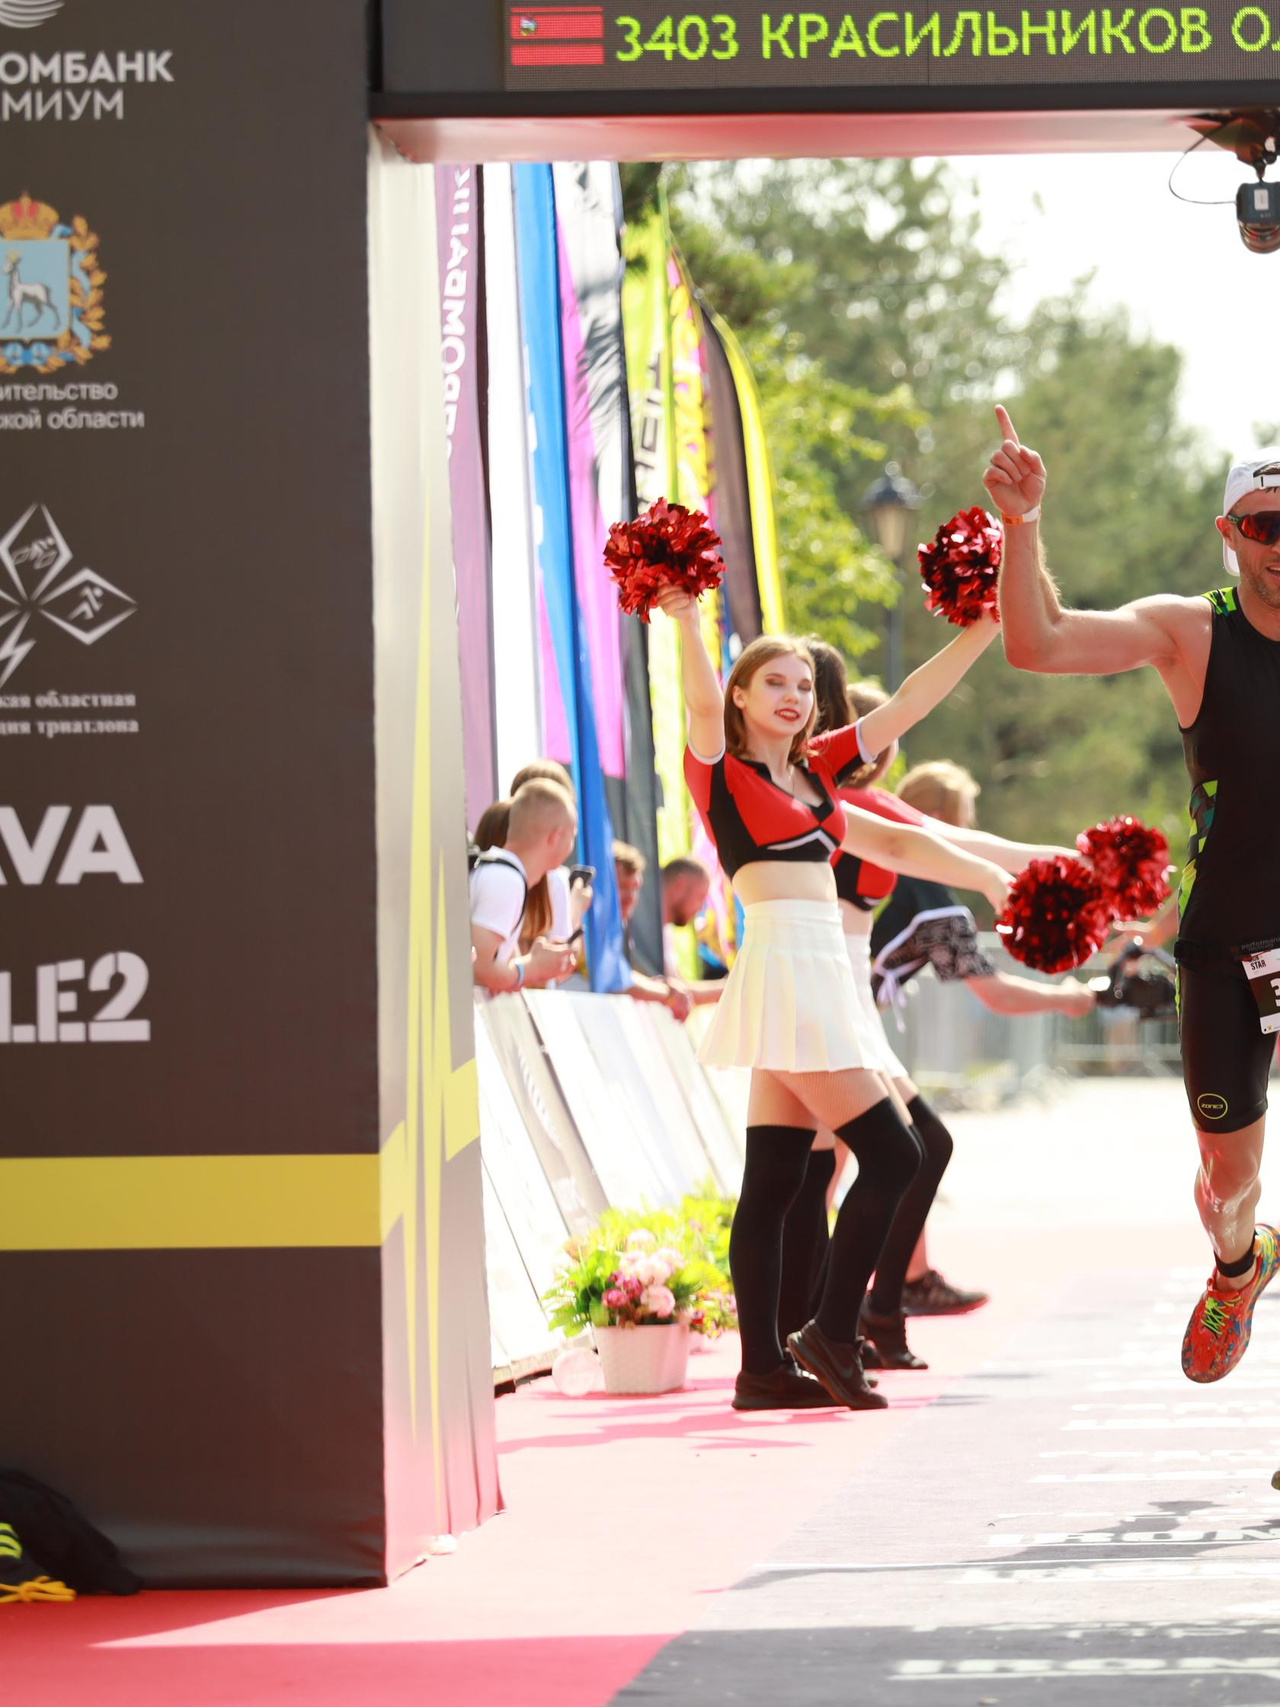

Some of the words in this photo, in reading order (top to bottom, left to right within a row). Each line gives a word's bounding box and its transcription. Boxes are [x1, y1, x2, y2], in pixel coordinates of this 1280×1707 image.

[615, 13, 740, 62] 3403
[761, 6, 1213, 60] КРАСИЛЬНИКОВ
[0, 50, 174, 85] ОМБАНК
[2, 90, 124, 121] МИУМ
[47, 407, 145, 429] области
[35, 690, 136, 707] областная
[37, 720, 139, 738] триатлона
[0, 805, 144, 885] VA
[1250, 959, 1267, 971] STAR
